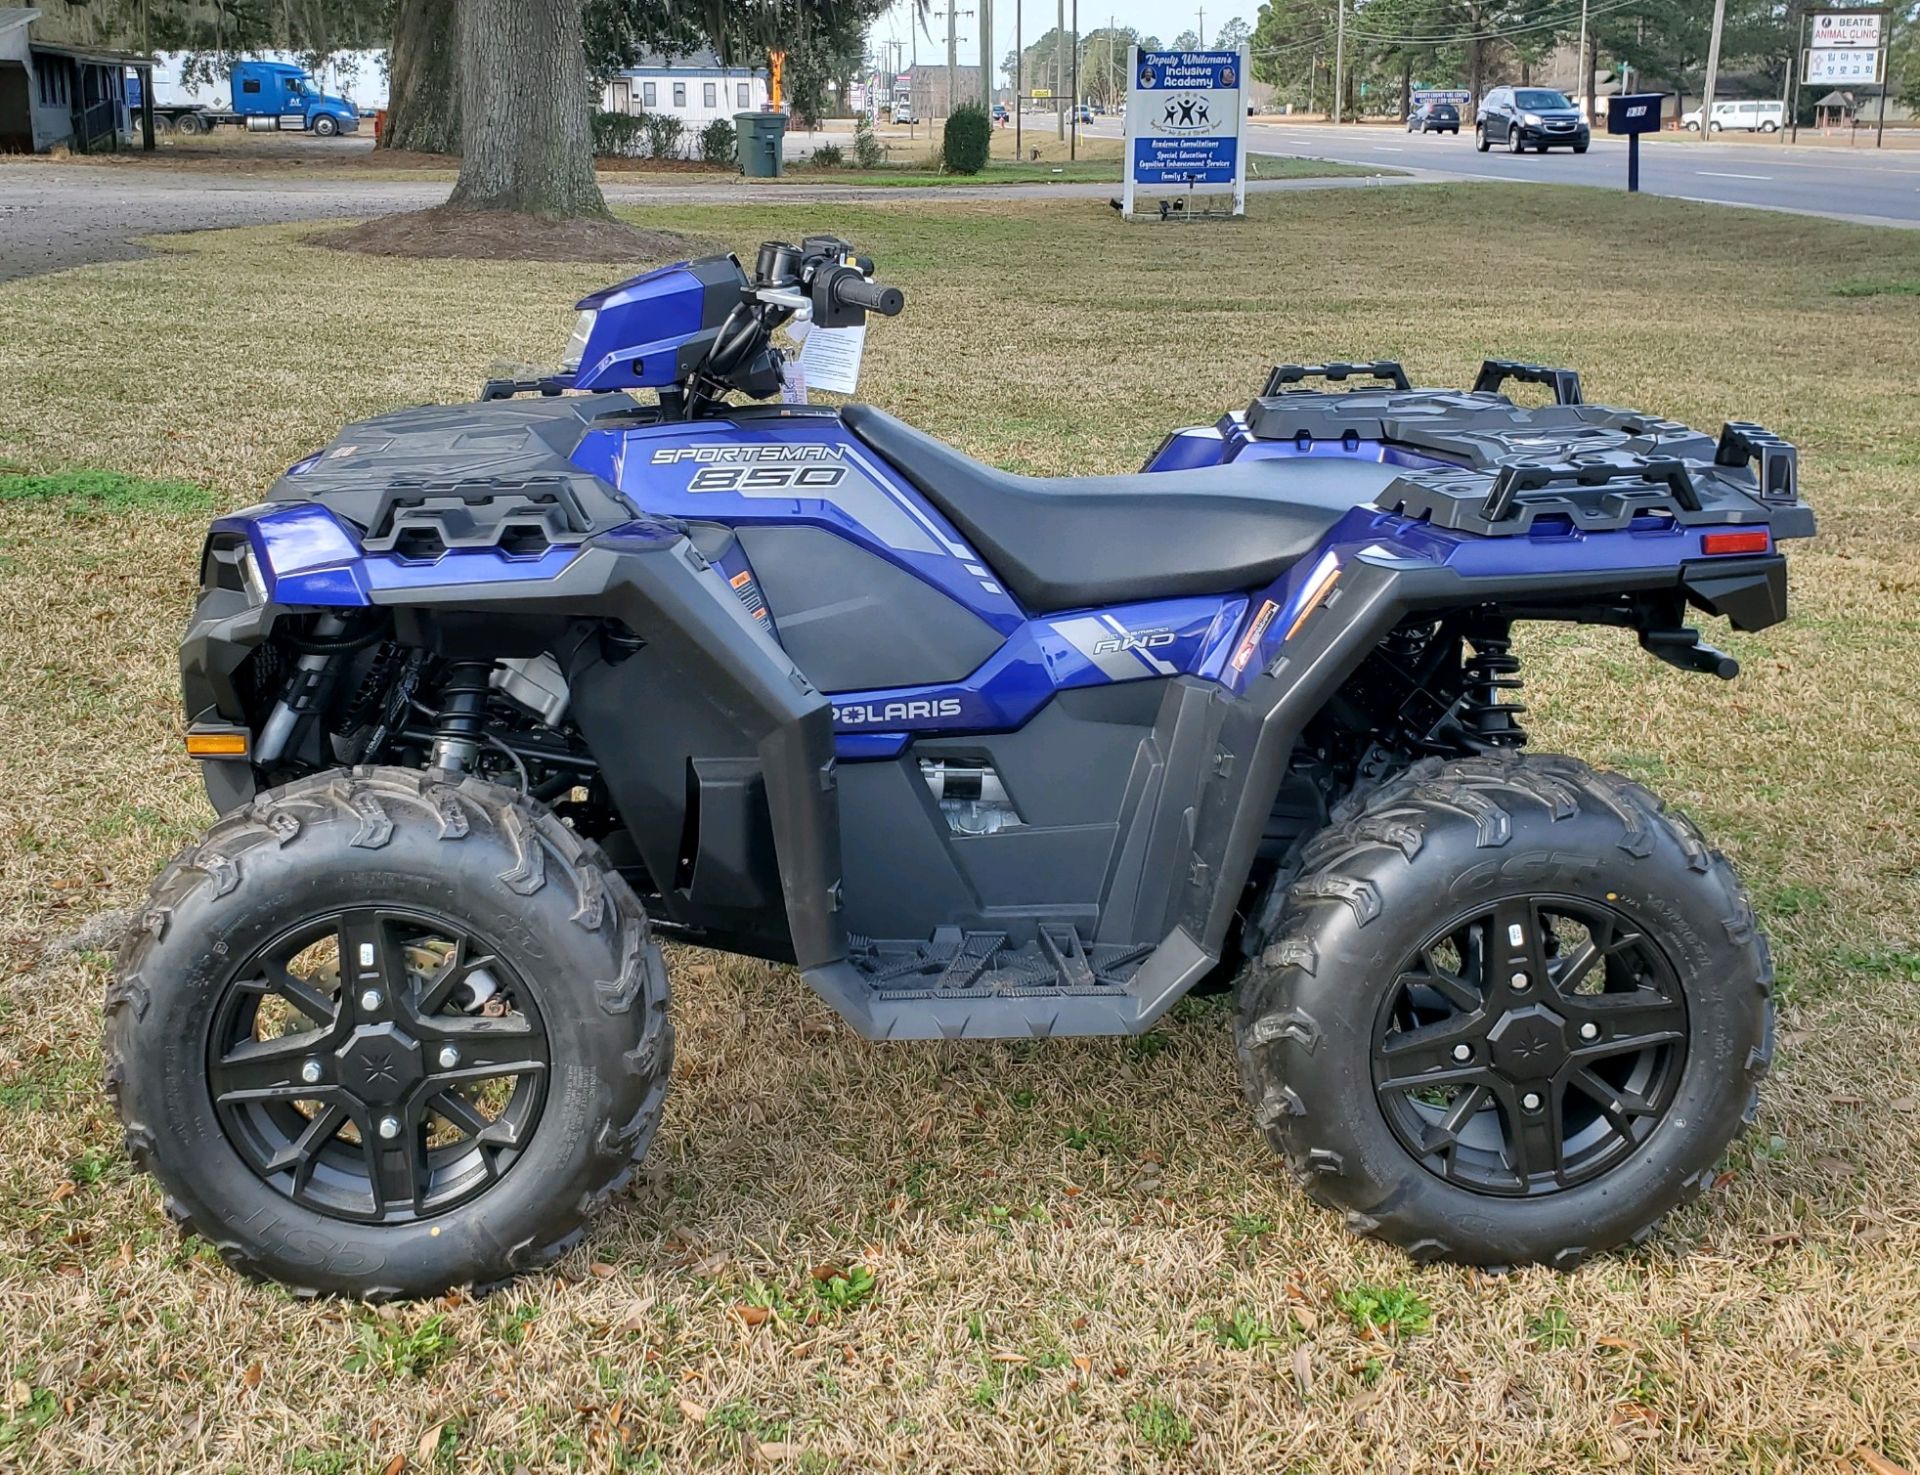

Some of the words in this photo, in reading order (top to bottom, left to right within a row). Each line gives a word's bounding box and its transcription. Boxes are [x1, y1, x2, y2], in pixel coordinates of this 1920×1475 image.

[1839, 18, 1874, 27] BEATIE
[1815, 30, 1847, 39] ANIMAL
[1849, 30, 1878, 39] CLINIC
[1146, 54, 1179, 67] Deputy
[1165, 66, 1212, 76] Inclusive
[1163, 77, 1214, 88] Academy
[1151, 140, 1179, 149] Academic
[1156, 151, 1177, 160] Special
[1180, 151, 1206, 159] Education
[1139, 160, 1165, 170] Cognitive
[1166, 160, 1205, 168] Enhancement
[1206, 160, 1231, 168] Services
[1161, 172, 1181, 181] Family
[651, 446, 846, 465] SPORTSMAN
[687, 465, 849, 493] 850
[1093, 632, 1176, 655] AWD
